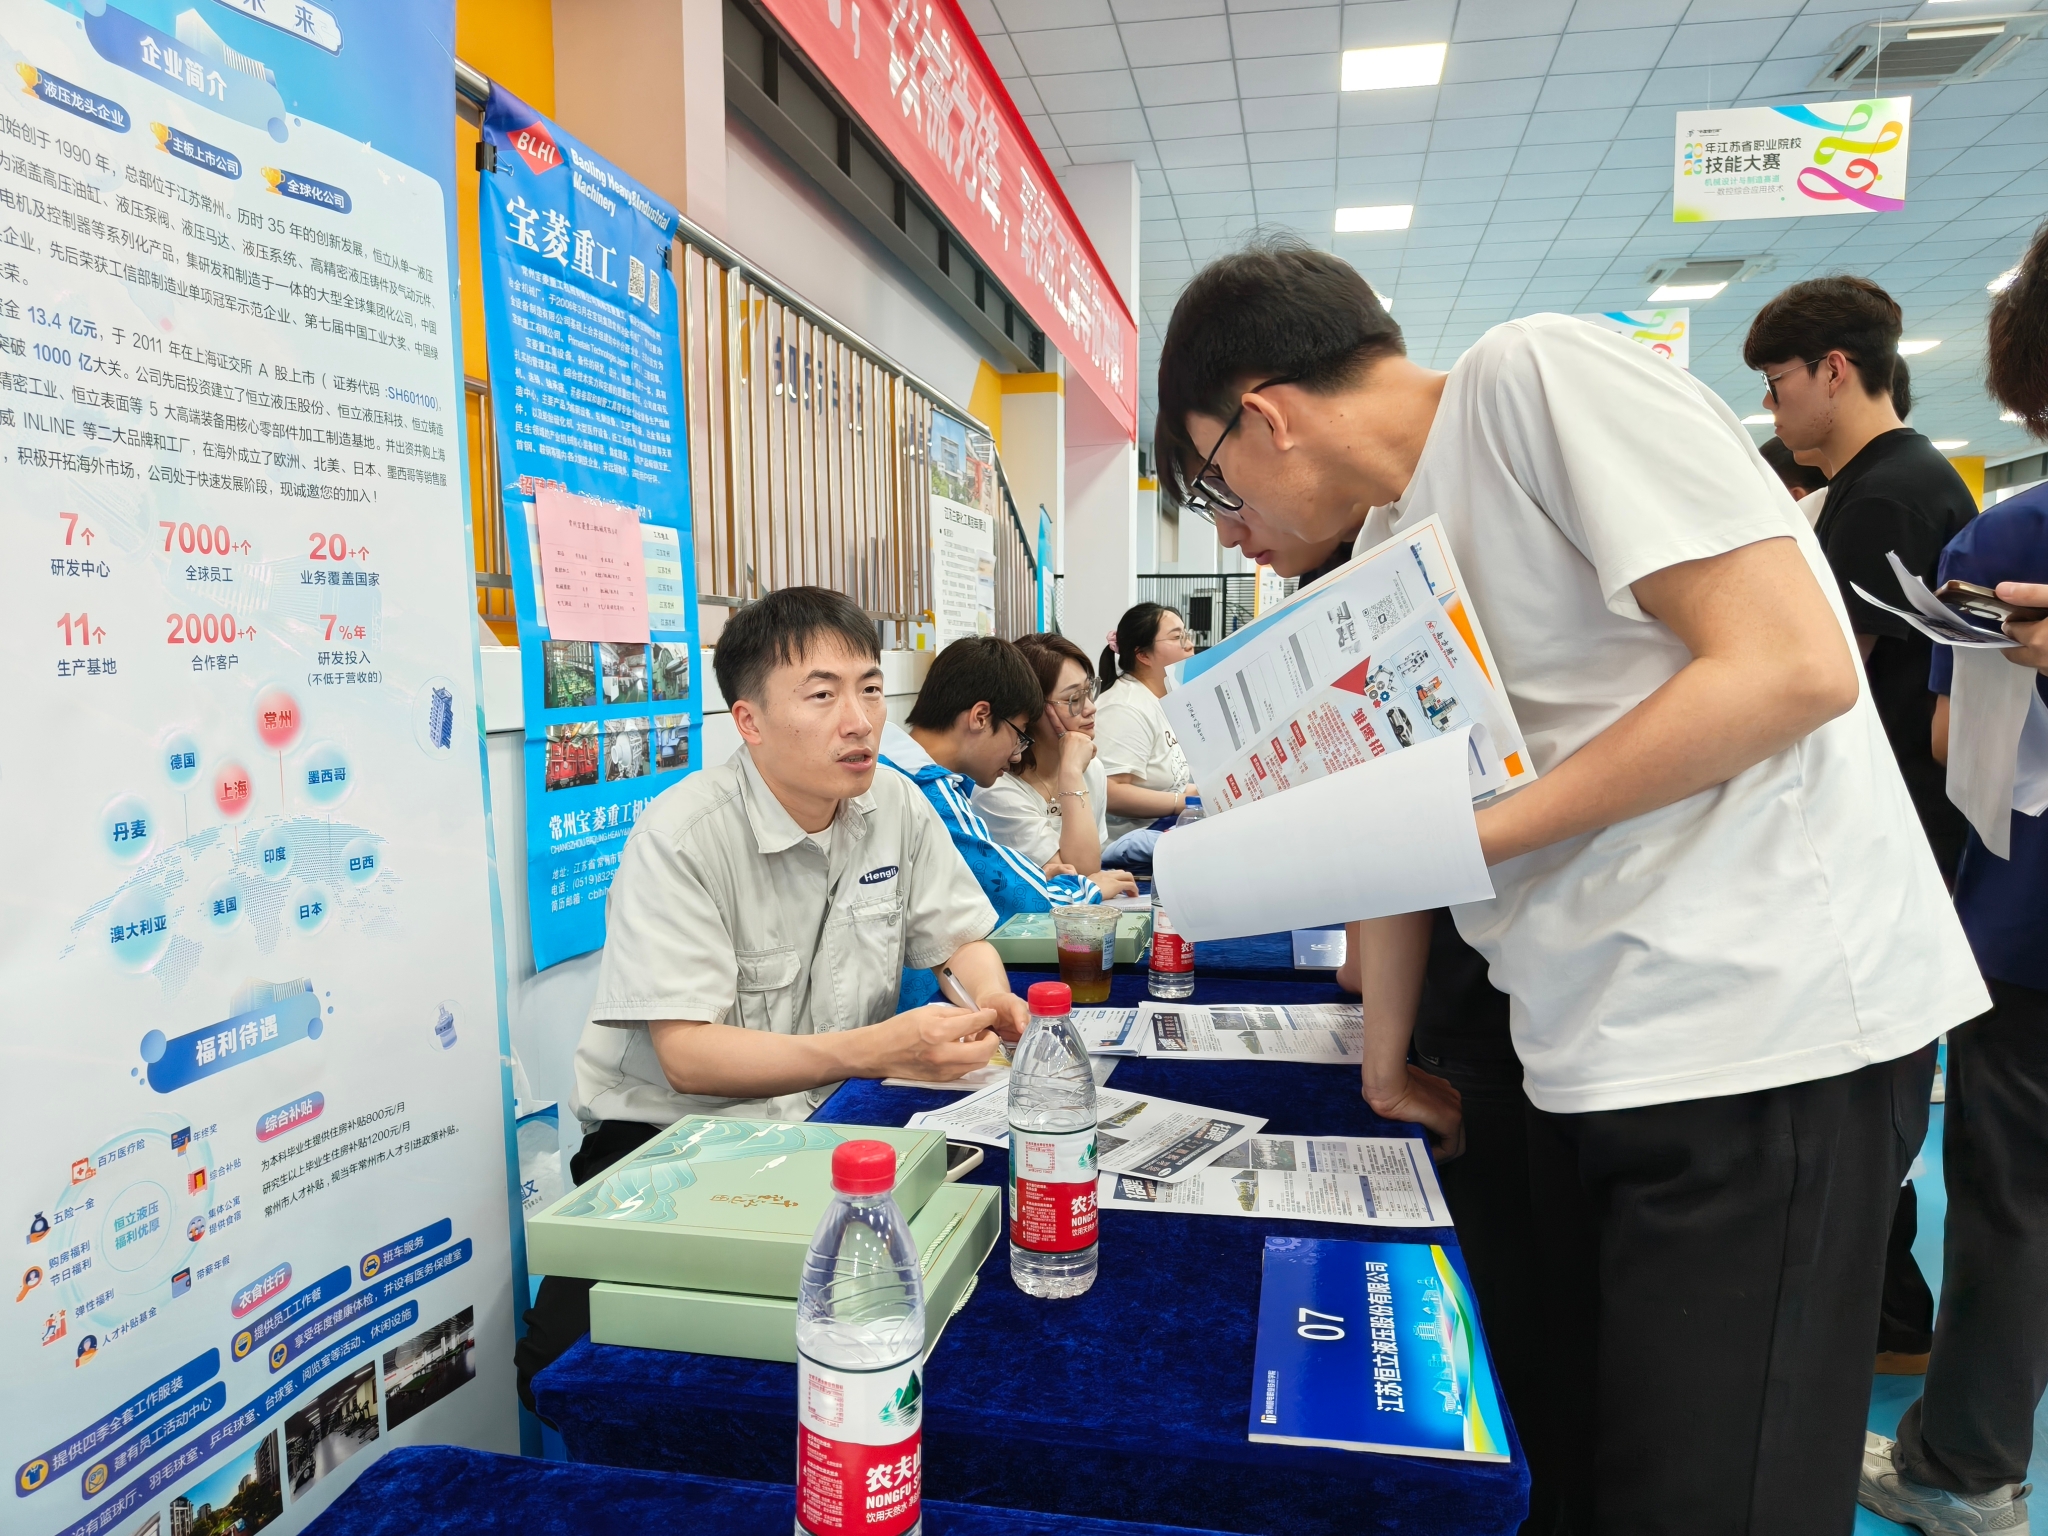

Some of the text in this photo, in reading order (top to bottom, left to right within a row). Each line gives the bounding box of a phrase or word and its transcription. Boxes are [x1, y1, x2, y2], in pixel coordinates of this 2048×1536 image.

[139, 35, 229, 102] 企业简介
[43, 78, 126, 128] 液压龙头企业
[172, 136, 240, 176] 主板上市公司
[517, 131, 557, 165] BLHI
[1705, 137, 1802, 155] 年江苏省职业院校
[570, 147, 607, 188] Baoling
[1705, 153, 1781, 174] 技能大赛
[55, 138, 91, 166] 1990
[95, 153, 263, 230] 年，总部位于江苏常州。历时
[267, 217, 286, 235] 35
[286, 178, 345, 210] 全球化公司
[572, 171, 617, 218] Machinery
[505, 194, 618, 289] 宝菱重工
[0, 226, 438, 360] 企业，先后荣获工信部制造业单项冠军示范企业、第七届中国工业大奖、中国绿
[27, 305, 62, 330] 13.4
[132, 332, 163, 354] 2011
[168, 340, 252, 377] 年在上海证交所
[258, 362, 269, 377] A
[274, 365, 316, 387] 股上市
[332, 374, 380, 398] 证券代码
[32, 342, 72, 367] 1000
[149, 400, 158, 417] 5
[23, 411, 76, 437] INLINE
[50, 558, 111, 579] 研发中心
[185, 564, 234, 583] 全球员工
[300, 569, 381, 588] 业务覆盖国家
[56, 657, 118, 678] 生产基地
[190, 653, 240, 673] 合作客户
[317, 650, 371, 666] 研发投入
[307, 670, 383, 687] (不低于营收的)
[263, 709, 294, 730] 常州
[170, 751, 196, 771] 德国
[307, 766, 347, 786] 墨西哥
[220, 780, 249, 802] 上海
[112, 819, 147, 842] 丹麦
[263, 846, 287, 864] 印度
[348, 854, 375, 872] 巴西
[863, 866, 898, 883] Hengli
[212, 896, 238, 916] 美国
[299, 901, 323, 919] 日本
[109, 914, 168, 944] 澳大利亚
[195, 1013, 280, 1068] 福利待遇
[264, 1097, 314, 1134] 综合补贴
[193, 1123, 219, 1143] 年终奖
[260, 1100, 406, 1173] 为本科毕业生提供住房补贴800元/月
[97, 1137, 146, 1169] 百万医疗险
[261, 1119, 411, 1196] 研究生以上毕业生住房补贴1200元/月
[209, 1157, 243, 1182] 综合补贴
[53, 1196, 96, 1227] 五险一金
[113, 1200, 160, 1232] 恒立液压
[207, 1194, 242, 1219] 集体公寓
[114, 1218, 161, 1251] 福利优厚
[208, 1210, 243, 1235] 提供食宿
[48, 1239, 92, 1270] 购房福利
[382, 1235, 425, 1264] 班车服务
[49, 1257, 93, 1287] 节日福利
[195, 1254, 231, 1281] 带薪年假
[74, 1287, 115, 1318] 弹性福利
[238, 1266, 287, 1311] 衣食住行
[101, 1305, 158, 1348] 人才补贴基金
[252, 1287, 323, 1342] 提供员工工作餐
[1297, 1307, 1346, 1342] 07
[1365, 1261, 1405, 1413] 江苏恒立液压股份有限公司
[51, 1374, 184, 1470] 提供四季全套工作服装
[113, 1395, 214, 1473] 建有员工活动中心
[865, 1486, 912, 1510] NONGFU
[865, 1503, 908, 1523] 饮用天然水
